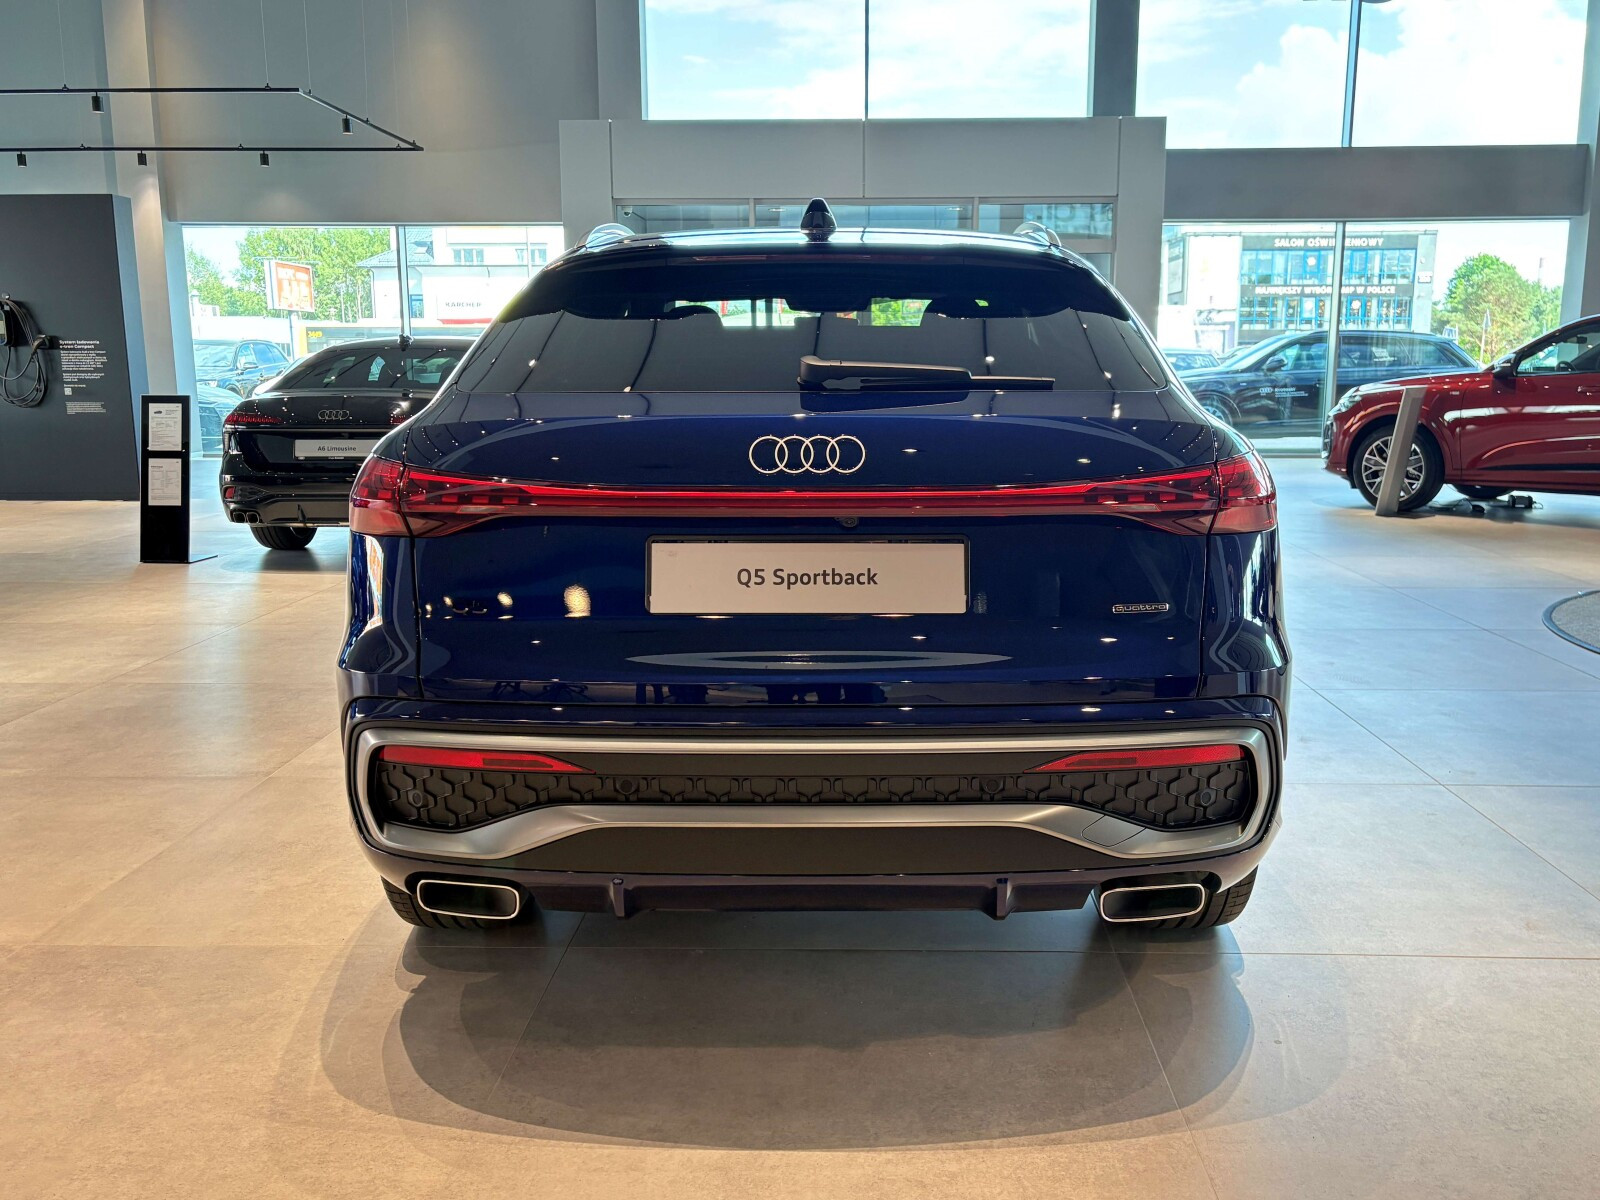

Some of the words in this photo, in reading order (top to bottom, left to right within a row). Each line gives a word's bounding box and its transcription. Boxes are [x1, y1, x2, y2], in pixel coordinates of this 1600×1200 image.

[1274, 237, 1305, 247] SALON
[736, 567, 766, 588] Q5
[772, 567, 879, 590] Sportback
